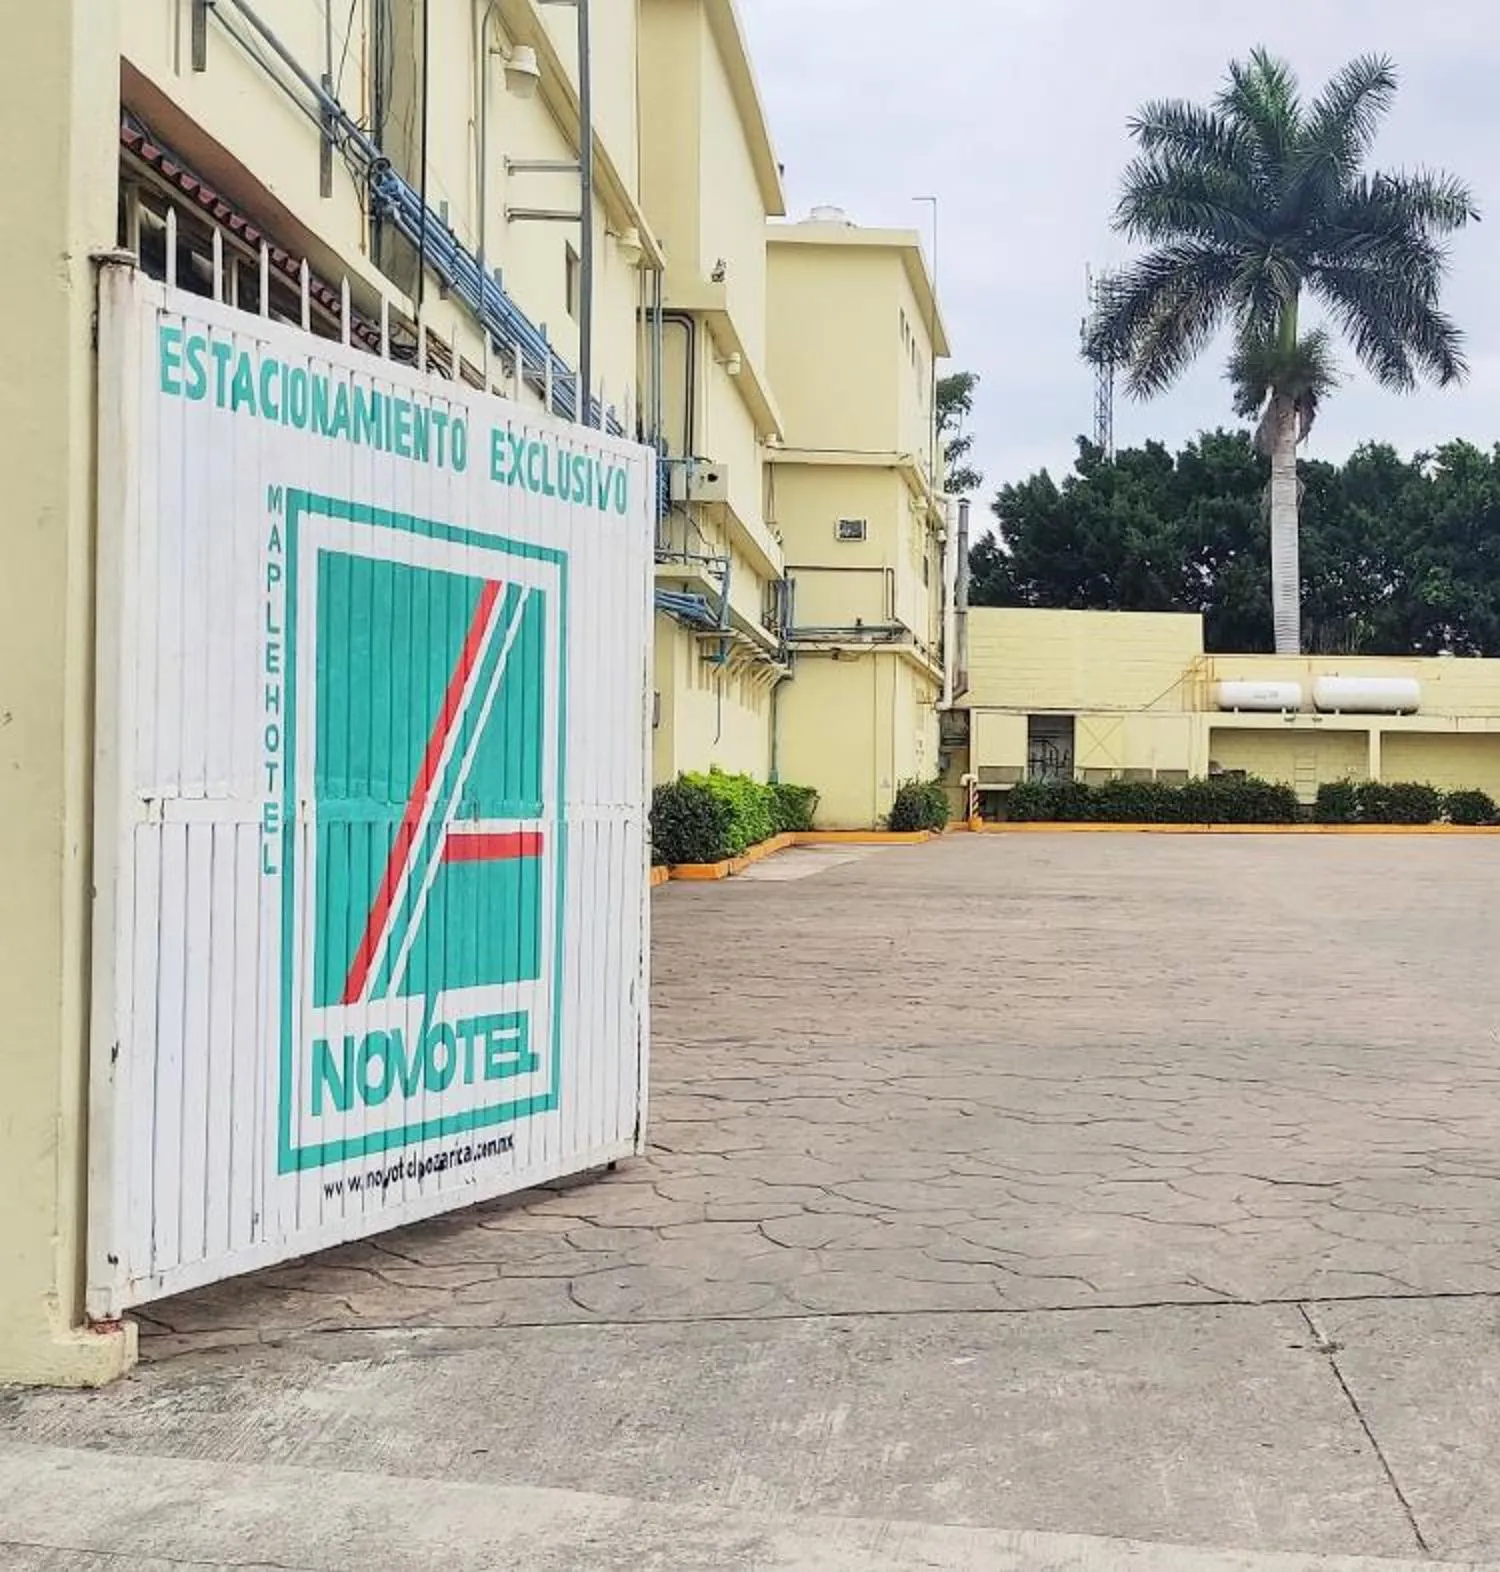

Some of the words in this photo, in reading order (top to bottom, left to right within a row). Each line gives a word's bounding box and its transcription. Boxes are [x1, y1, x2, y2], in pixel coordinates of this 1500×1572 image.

[159, 326, 468, 473] ESTACIONAMIENTO
[489, 428, 629, 515] EXCLUSIVO
[311, 1000, 539, 1117] NOVOTEL
